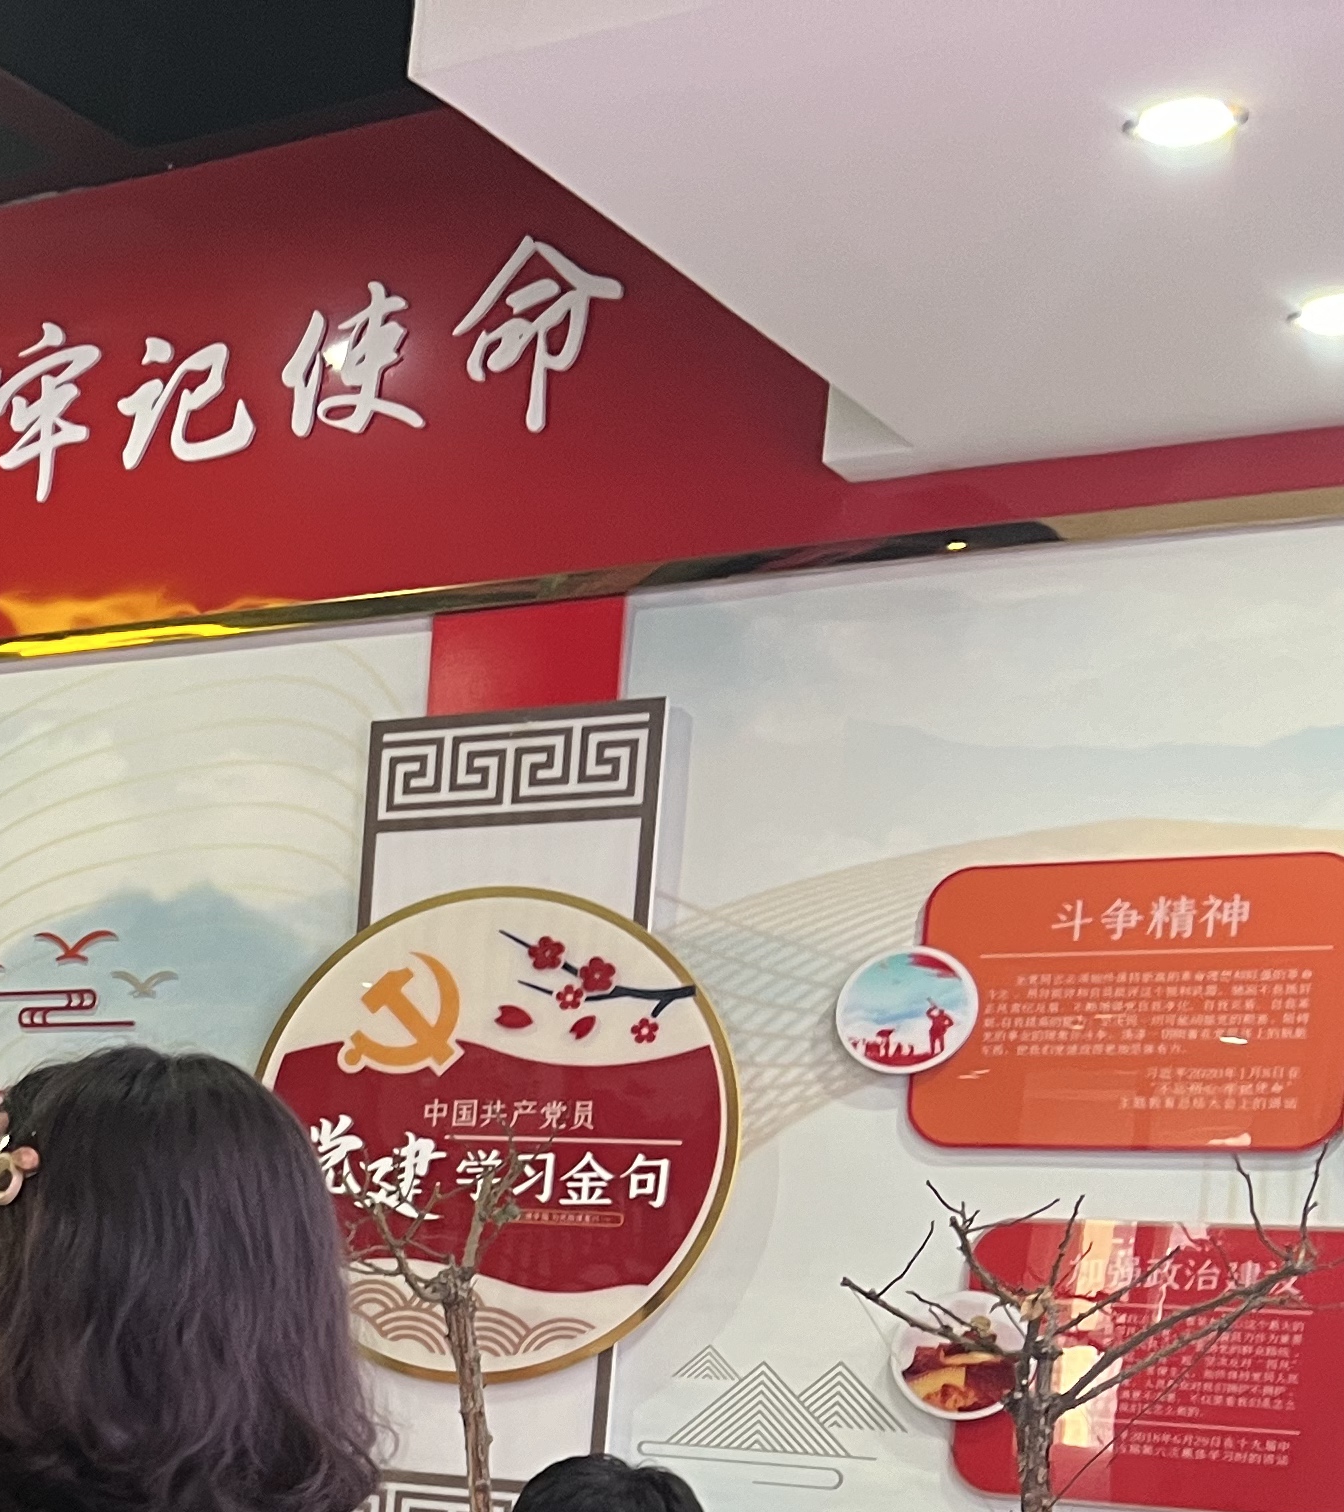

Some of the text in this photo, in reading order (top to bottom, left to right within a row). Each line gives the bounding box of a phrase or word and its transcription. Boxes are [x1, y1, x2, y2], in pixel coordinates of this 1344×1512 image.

[1051, 894, 1252, 941] 斗争精神
[424, 1097, 596, 1132] 中国共产党员
